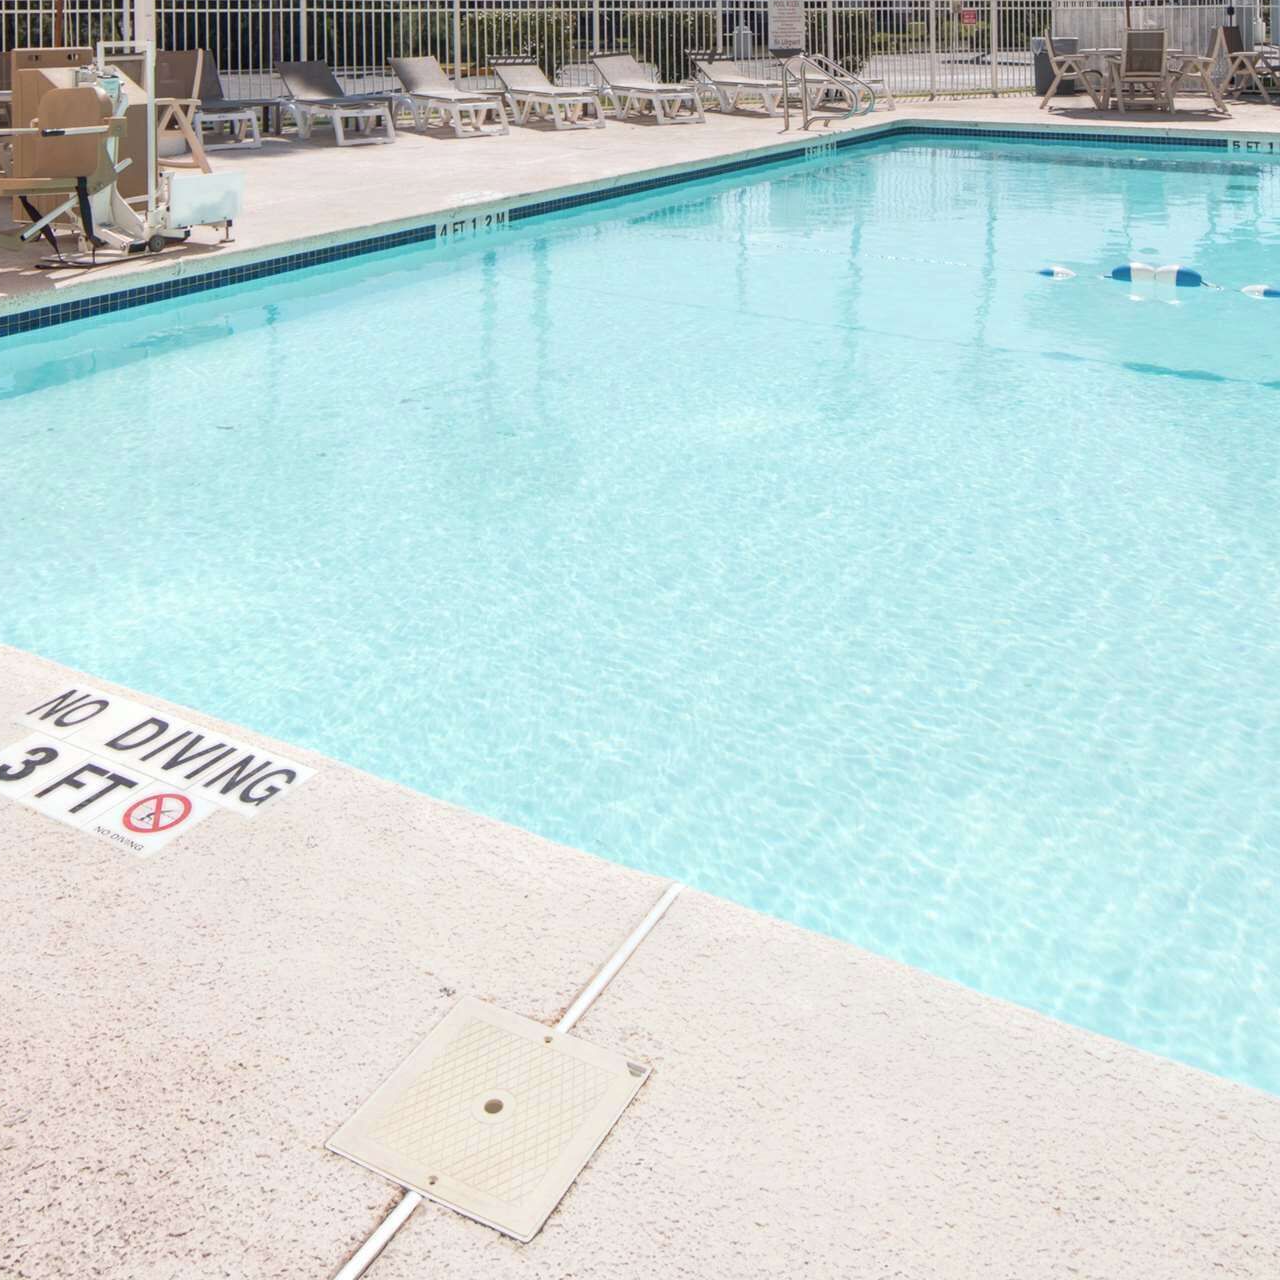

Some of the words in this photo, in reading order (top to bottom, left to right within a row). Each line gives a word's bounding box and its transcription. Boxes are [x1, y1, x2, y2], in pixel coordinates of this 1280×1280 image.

[453, 221, 466, 234] FT
[496, 211, 505, 224] M
[25, 688, 110, 728] NO
[103, 716, 297, 806] DIVING
[34, 762, 139, 814] FT
[93, 825, 111, 836] NO
[110, 833, 145, 851] DIVING
